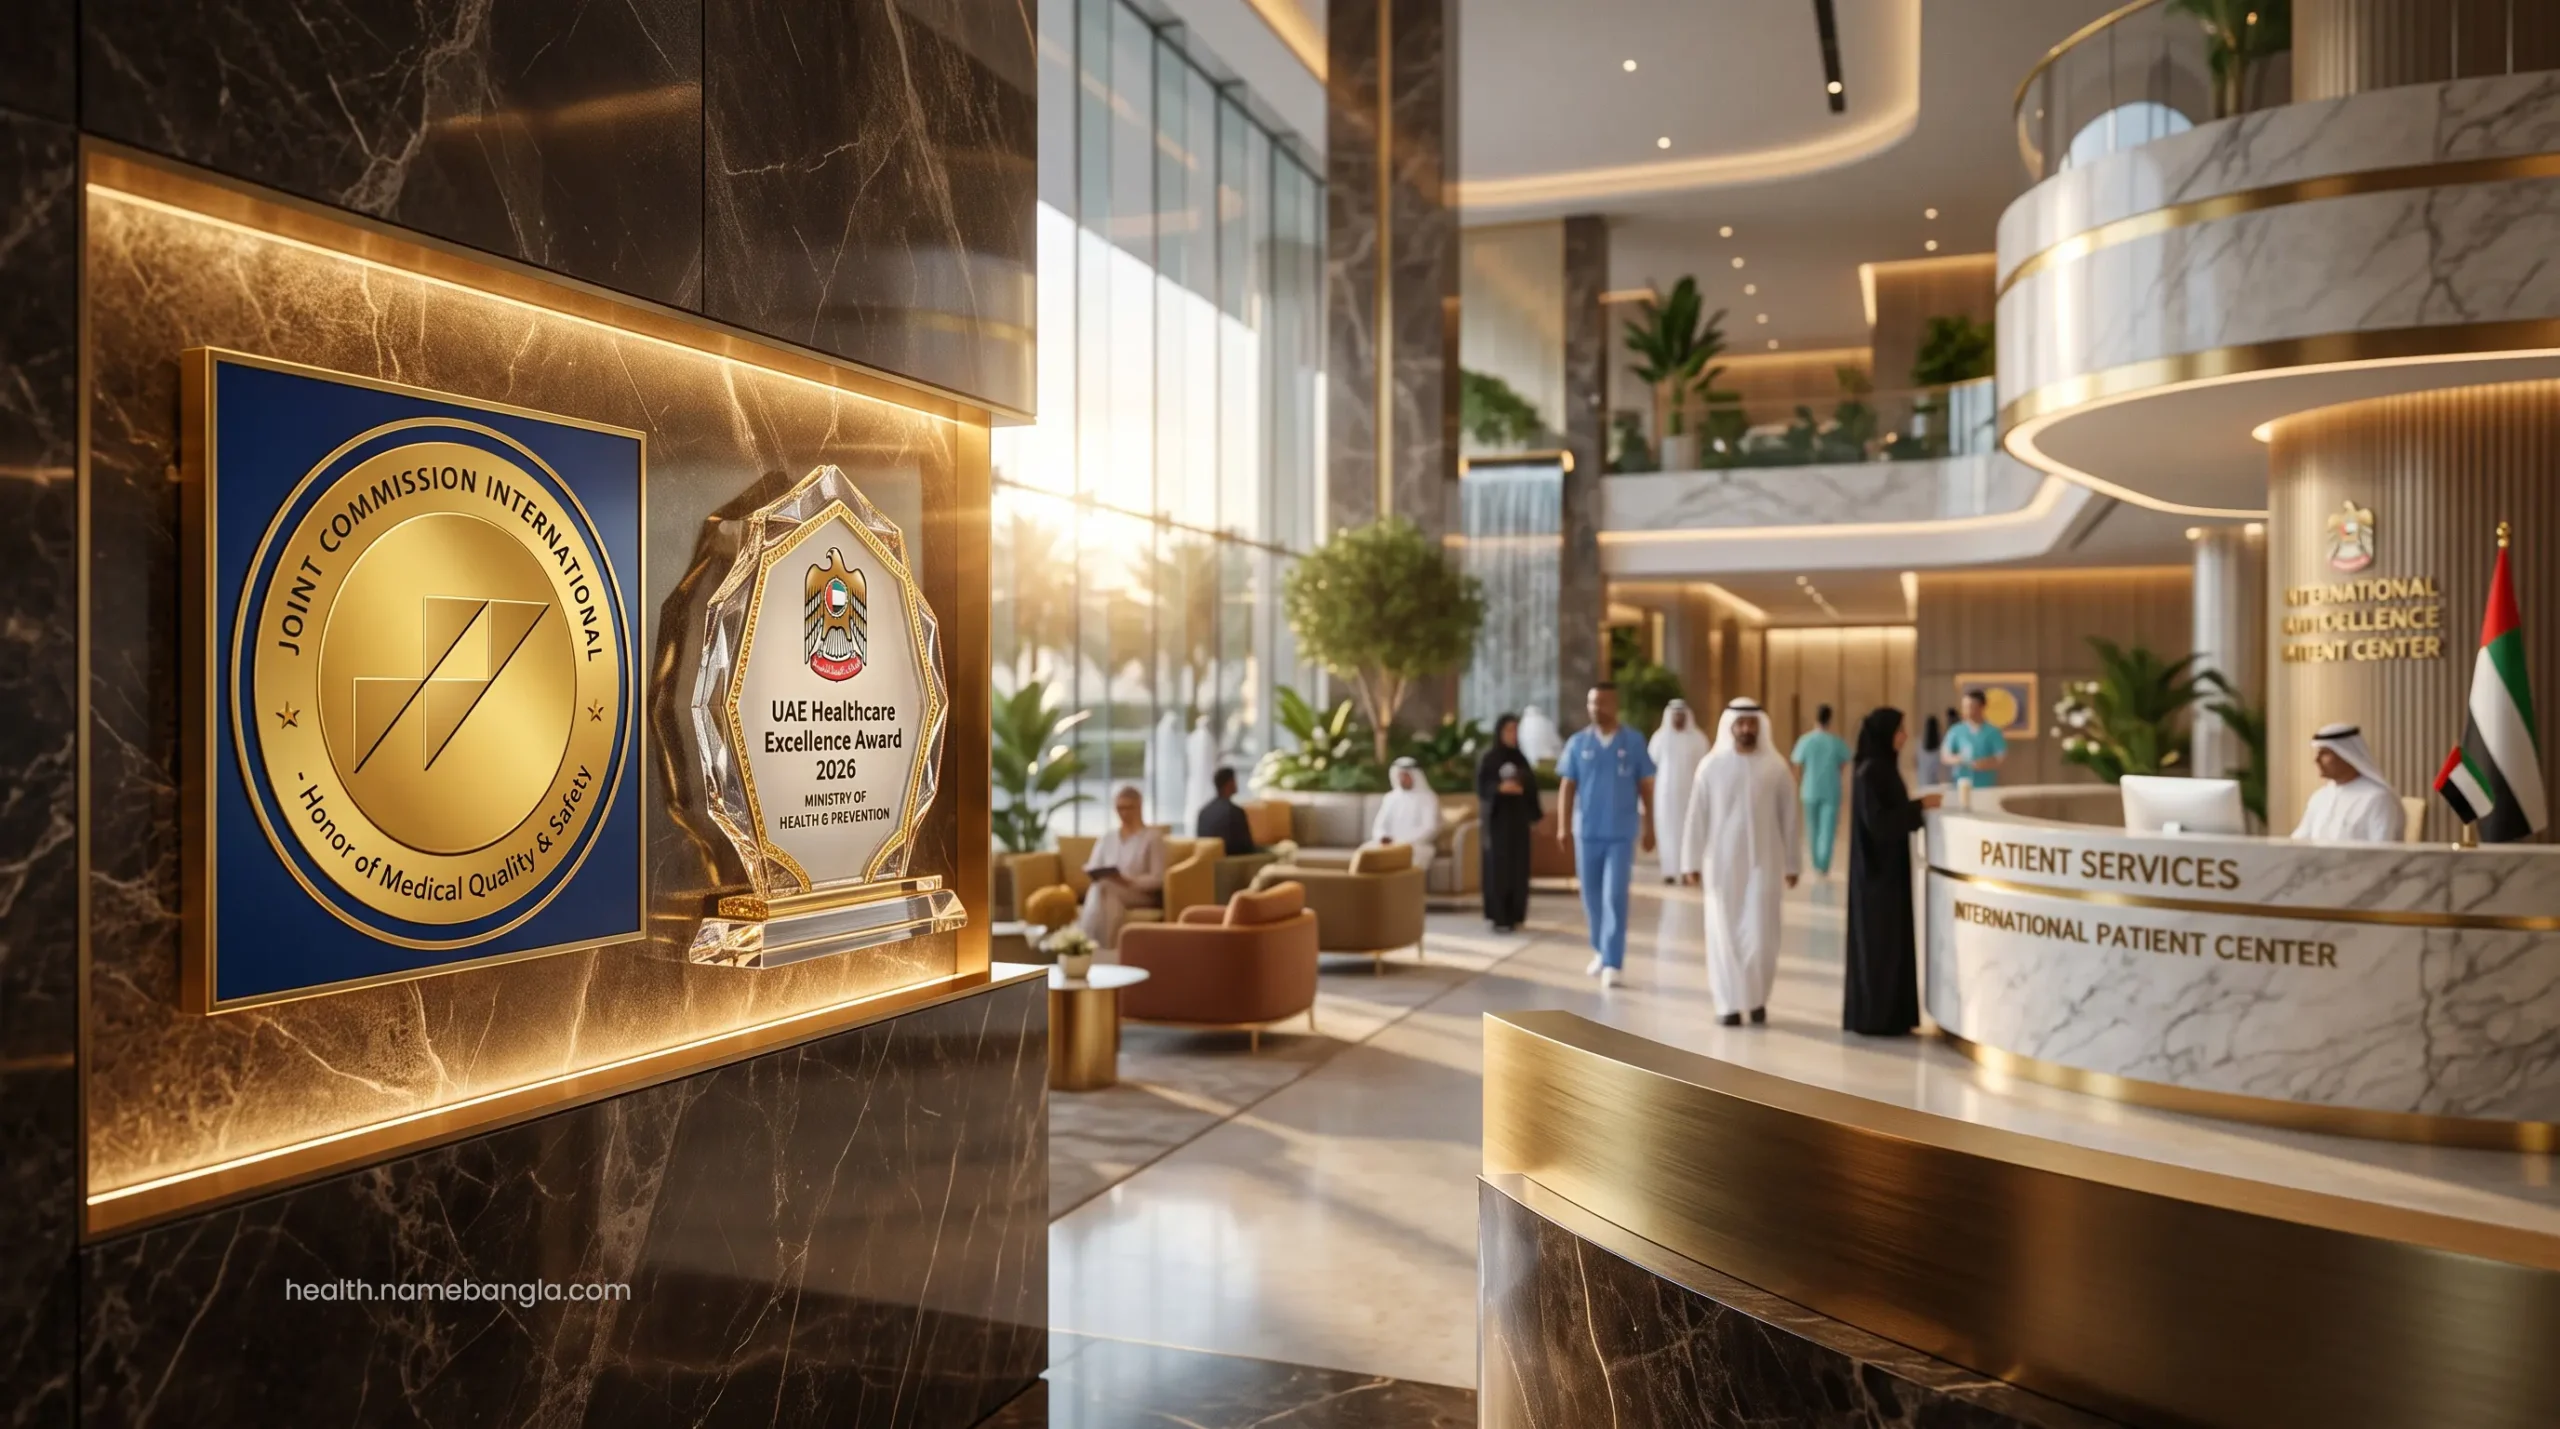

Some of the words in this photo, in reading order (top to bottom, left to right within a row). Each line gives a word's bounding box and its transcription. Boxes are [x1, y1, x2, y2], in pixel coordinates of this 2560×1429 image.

[278, 555, 322, 656] JOINT
[319, 466, 476, 553] COMMISSION
[485, 475, 602, 662] INTERNATIONAL
[2352, 635, 2441, 662] CENTER
[772, 700, 807, 722] UAE
[812, 700, 896, 722] Healthcare
[765, 729, 851, 753] Excellence
[854, 727, 902, 750] Award
[816, 758, 856, 780] 2026
[804, 791, 852, 808] MINISTRY
[853, 790, 867, 804] OF
[779, 813, 819, 830] HEALTH
[831, 807, 890, 825] PREVENTION
[299, 784, 356, 858] Honor
[355, 856, 382, 879] of
[379, 864, 462, 901] Medical
[469, 848, 535, 898] Quality
[536, 832, 553, 853] &
[549, 765, 592, 836] Safety
[1980, 840, 2073, 875] PATIENT
[2081, 850, 2241, 891] SERVICES
[1954, 900, 2089, 944] INTERNATIONAL
[2096, 922, 2207, 957] PATIENT
[2214, 934, 2338, 968] CENTER
